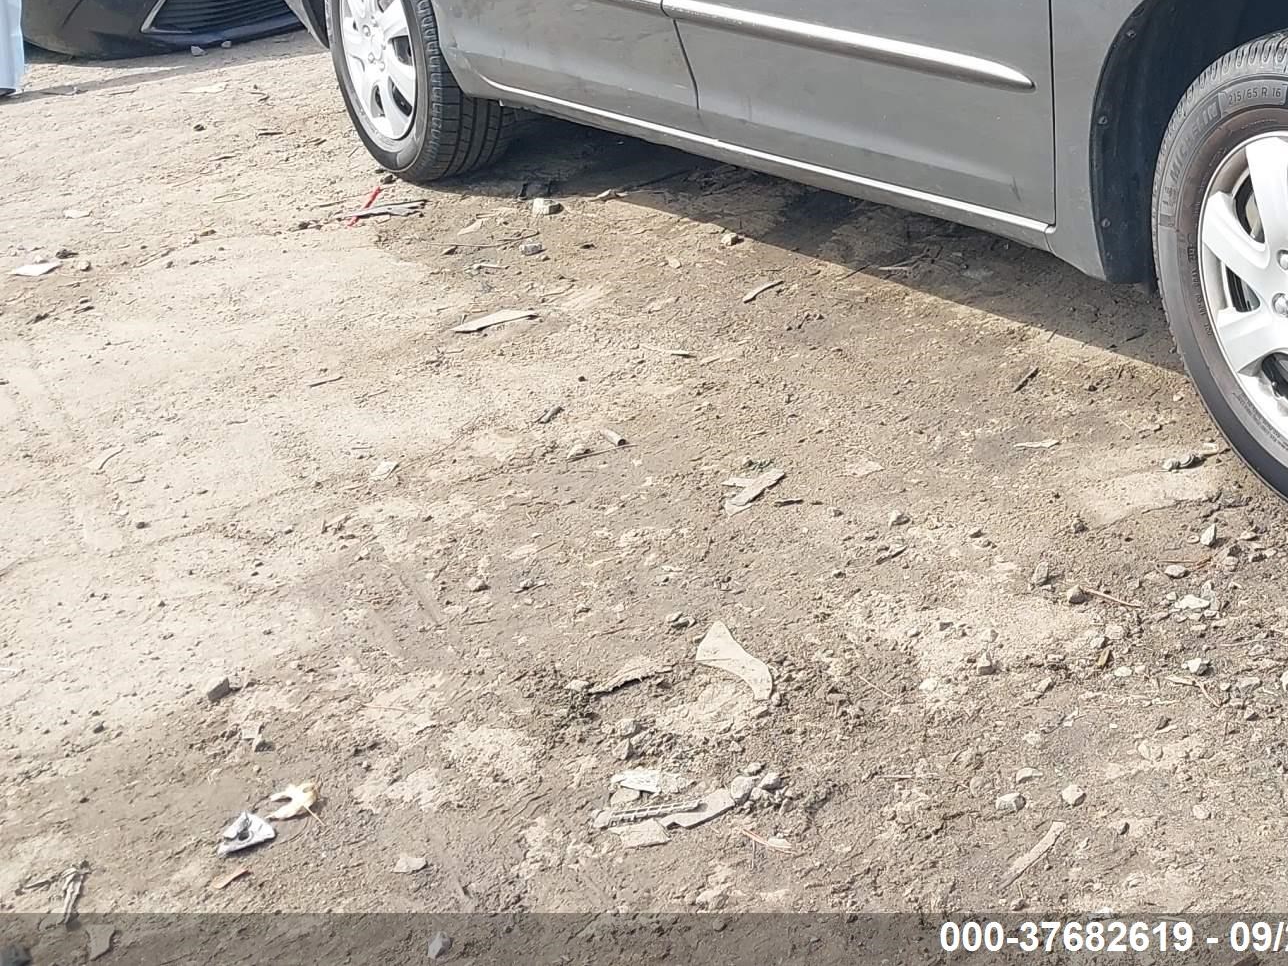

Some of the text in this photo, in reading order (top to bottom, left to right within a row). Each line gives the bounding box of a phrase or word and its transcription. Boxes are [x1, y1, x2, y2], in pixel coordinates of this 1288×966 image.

[1229, 86, 1282, 105] 215/65 R 16
